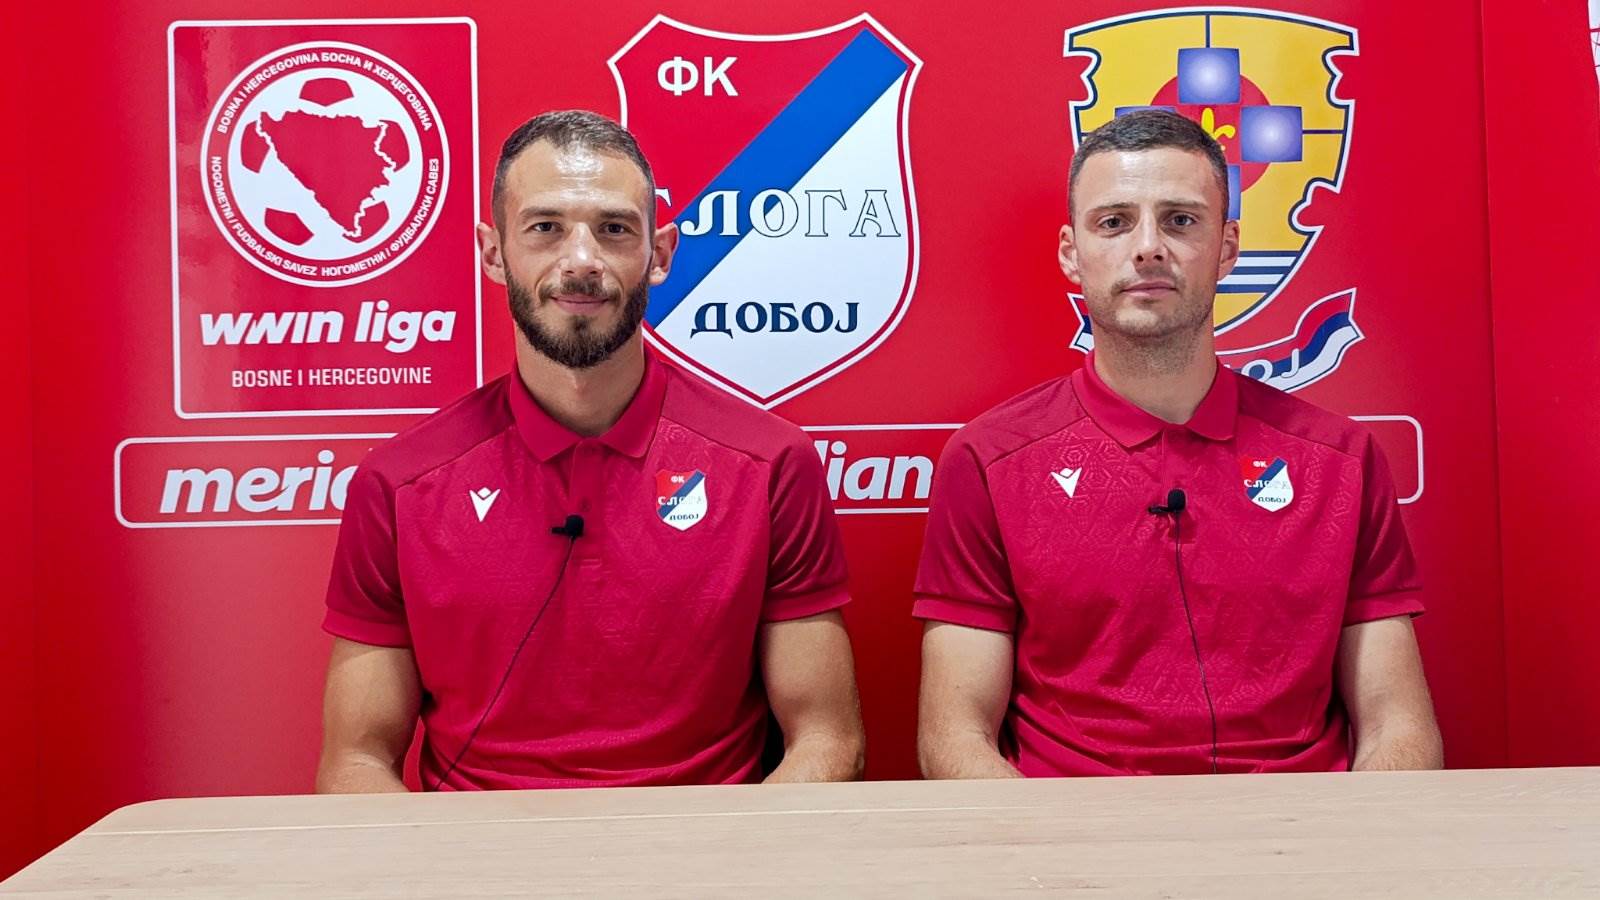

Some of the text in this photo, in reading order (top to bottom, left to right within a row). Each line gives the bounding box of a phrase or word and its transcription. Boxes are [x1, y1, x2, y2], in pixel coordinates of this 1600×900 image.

[217, 96, 245, 134] BOSNA
[243, 53, 320, 94] HERCEGOVINA
[321, 52, 433, 131] БОСНА И ХЕРЦЕГОВИНА
[657, 56, 739, 97] ФК
[211, 156, 236, 220] NOGOMETNI
[232, 223, 283, 266] FUDBALSKI
[281, 259, 318, 276] SAVEZ
[321, 250, 387, 276] НОГОМЕТНИ
[390, 195, 434, 252] ФУДБАЛСКИ
[426, 158, 439, 195] САВЕЗ
[654, 188, 902, 238] ЛОГА
[354, 300, 456, 353] liga
[690, 301, 859, 339] ДОБОЈ
[232, 366, 432, 388] BOSNE I HERCEGOVINE
